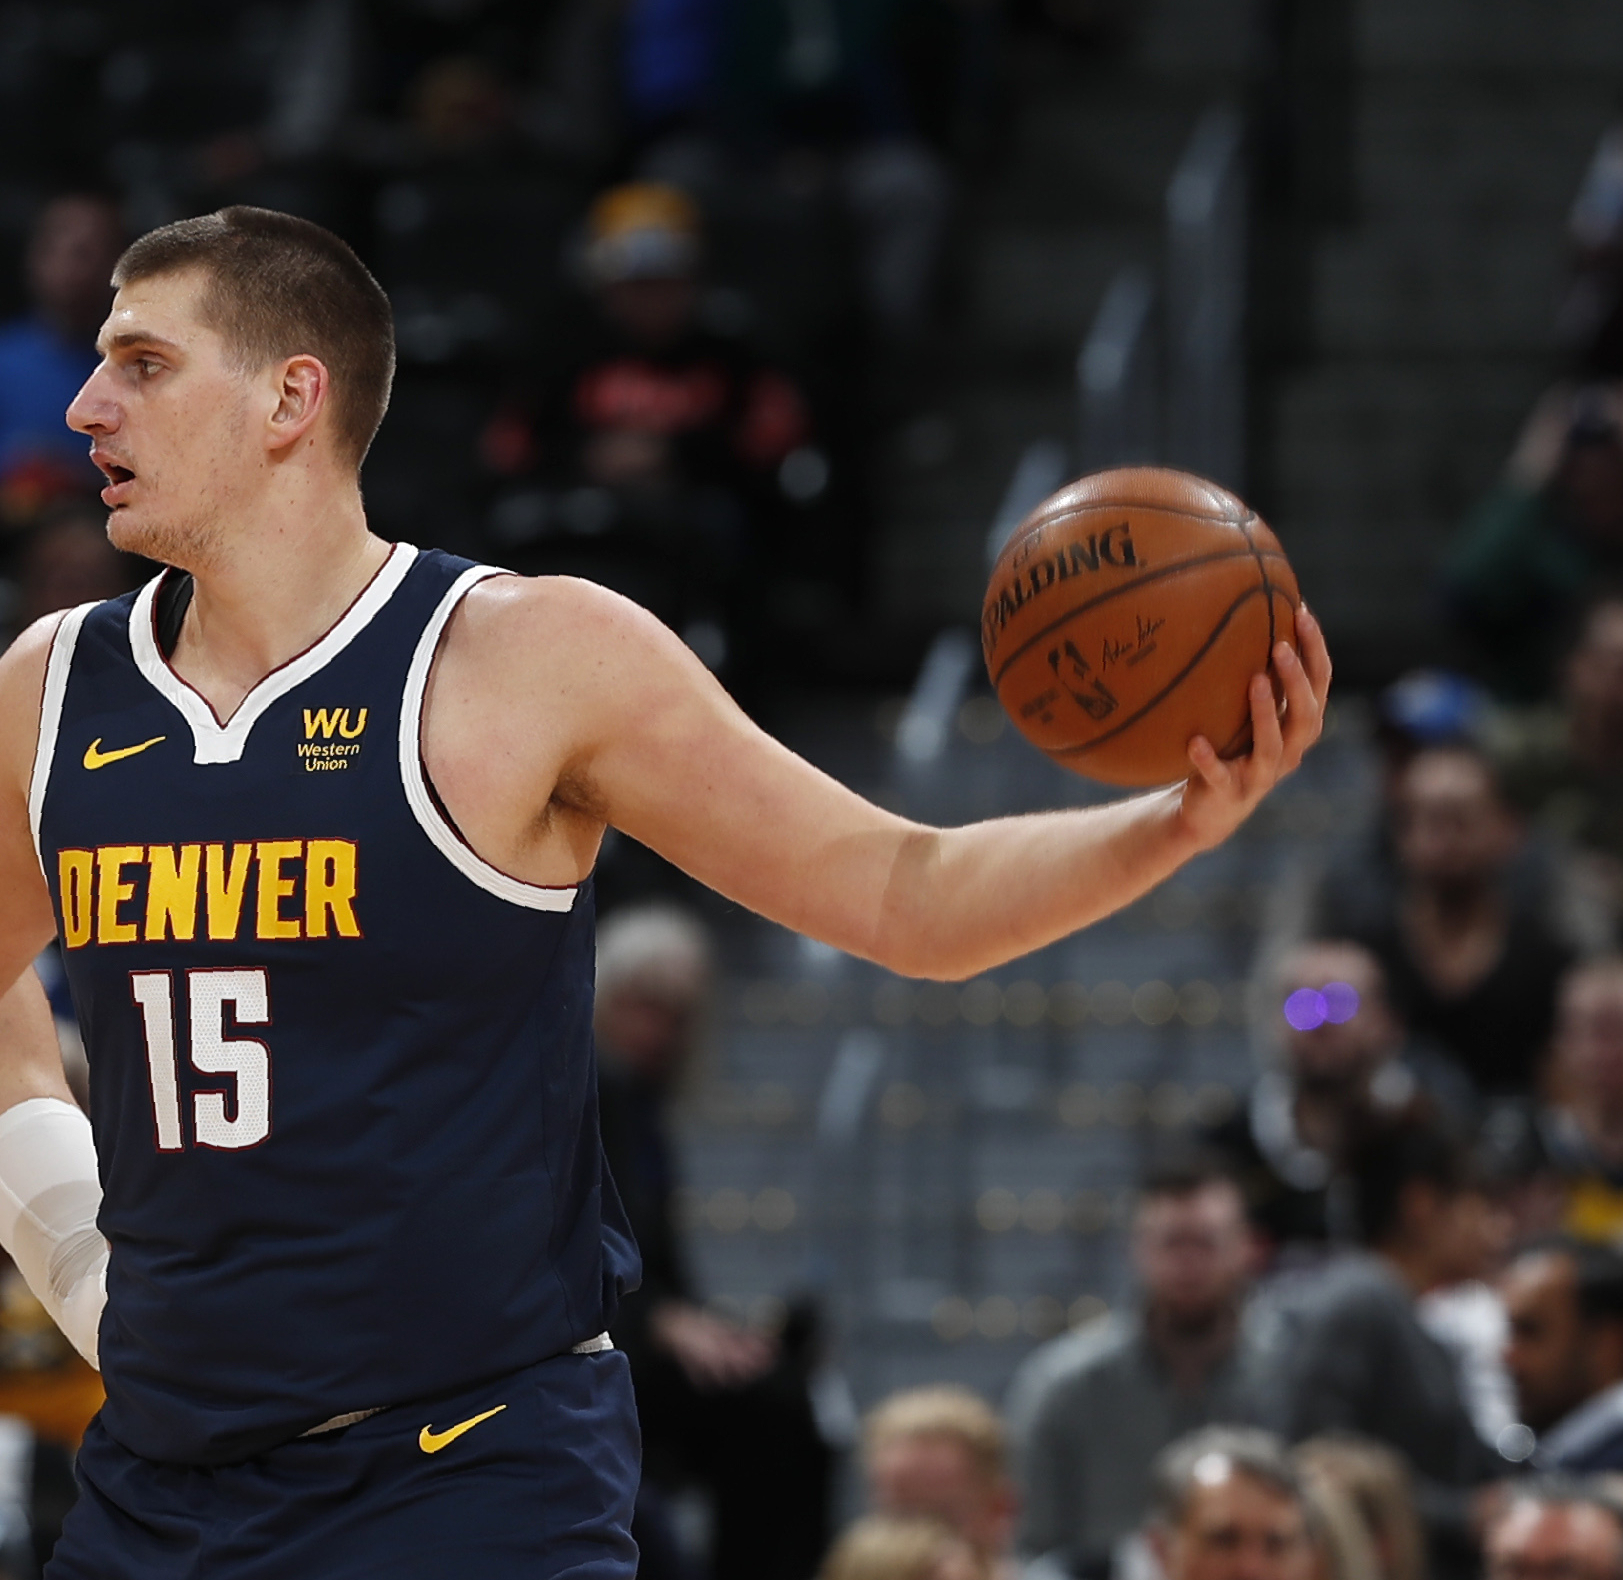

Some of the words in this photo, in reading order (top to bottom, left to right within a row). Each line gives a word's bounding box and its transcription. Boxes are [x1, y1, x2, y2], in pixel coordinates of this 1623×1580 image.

[303, 707, 368, 739] WU
[297, 742, 360, 757] Western
[305, 756, 348, 772] Union
[58, 837, 364, 951] DENVER
[129, 966, 272, 1153] 15
